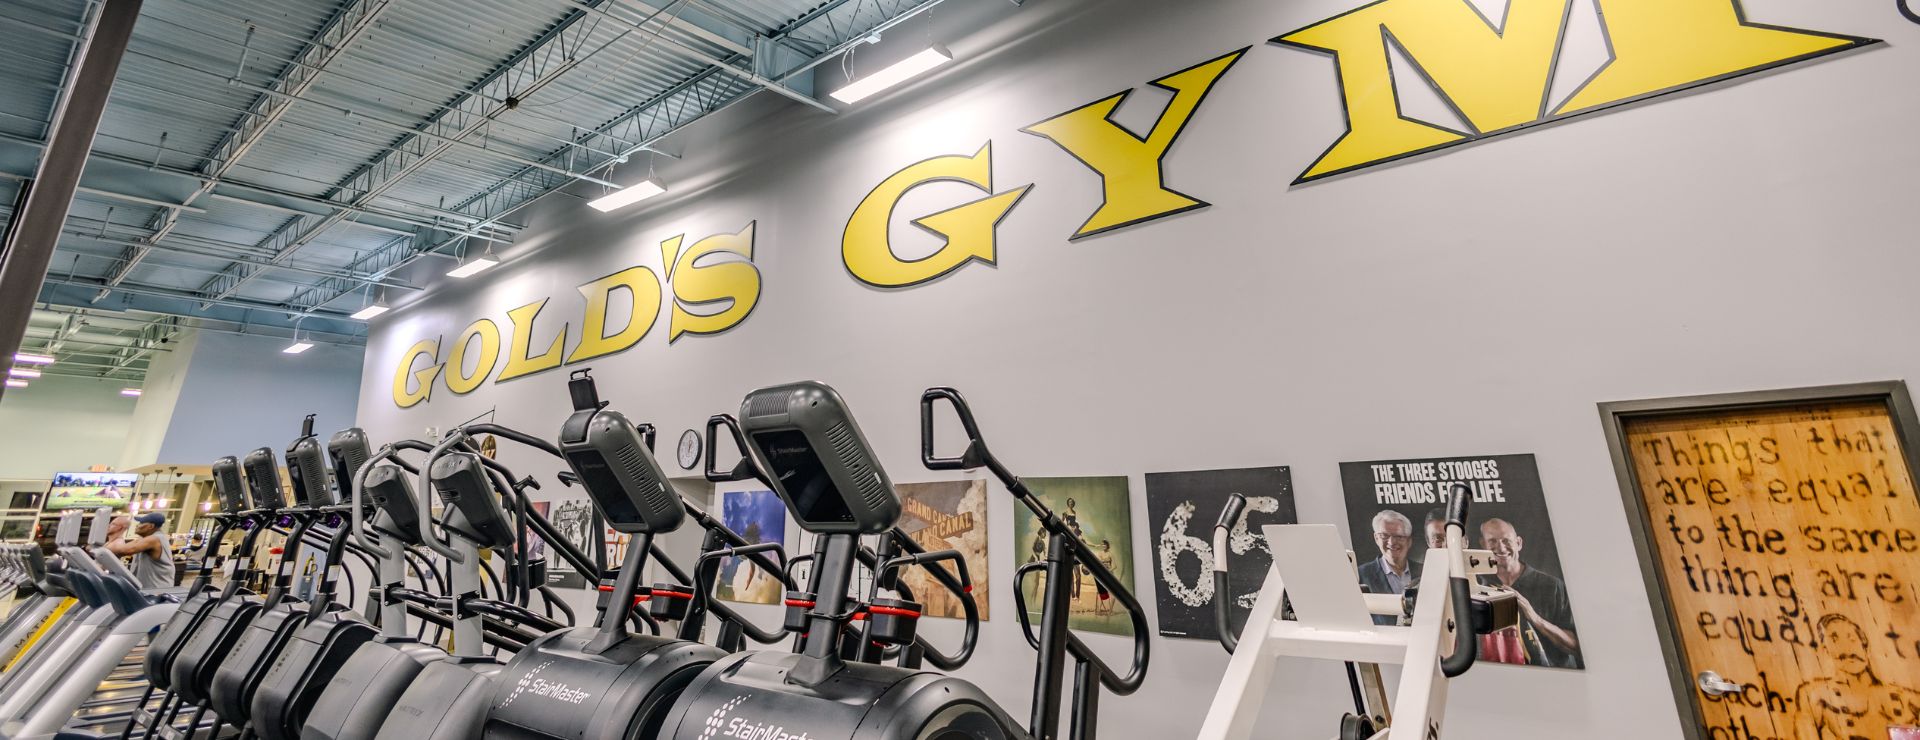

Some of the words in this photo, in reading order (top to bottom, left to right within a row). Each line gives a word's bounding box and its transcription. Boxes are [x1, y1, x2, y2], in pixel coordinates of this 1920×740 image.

[393, 219, 761, 408] GOLD'S
[842, 0, 1883, 289] GYM
[1371, 464, 1395, 482] THE
[1396, 462, 1437, 481] THREE
[1438, 459, 1500, 480] STOOGES
[1643, 435, 1780, 477] Things
[1807, 423, 1887, 456] that
[1374, 482, 1436, 504] FRIENDS
[1470, 480, 1505, 502] LIFE
[1656, 477, 1731, 505] are
[1768, 459, 1898, 515] equal
[907, 497, 931, 520] GRAND
[939, 512, 972, 537] CANAL
[1667, 513, 1705, 545] to
[1716, 513, 1787, 555] the
[1799, 525, 1920, 554] same
[1681, 554, 1800, 618] thing
[1817, 568, 1904, 603] are
[1697, 611, 1818, 656] equal
[528, 678, 589, 704] StairMaster
